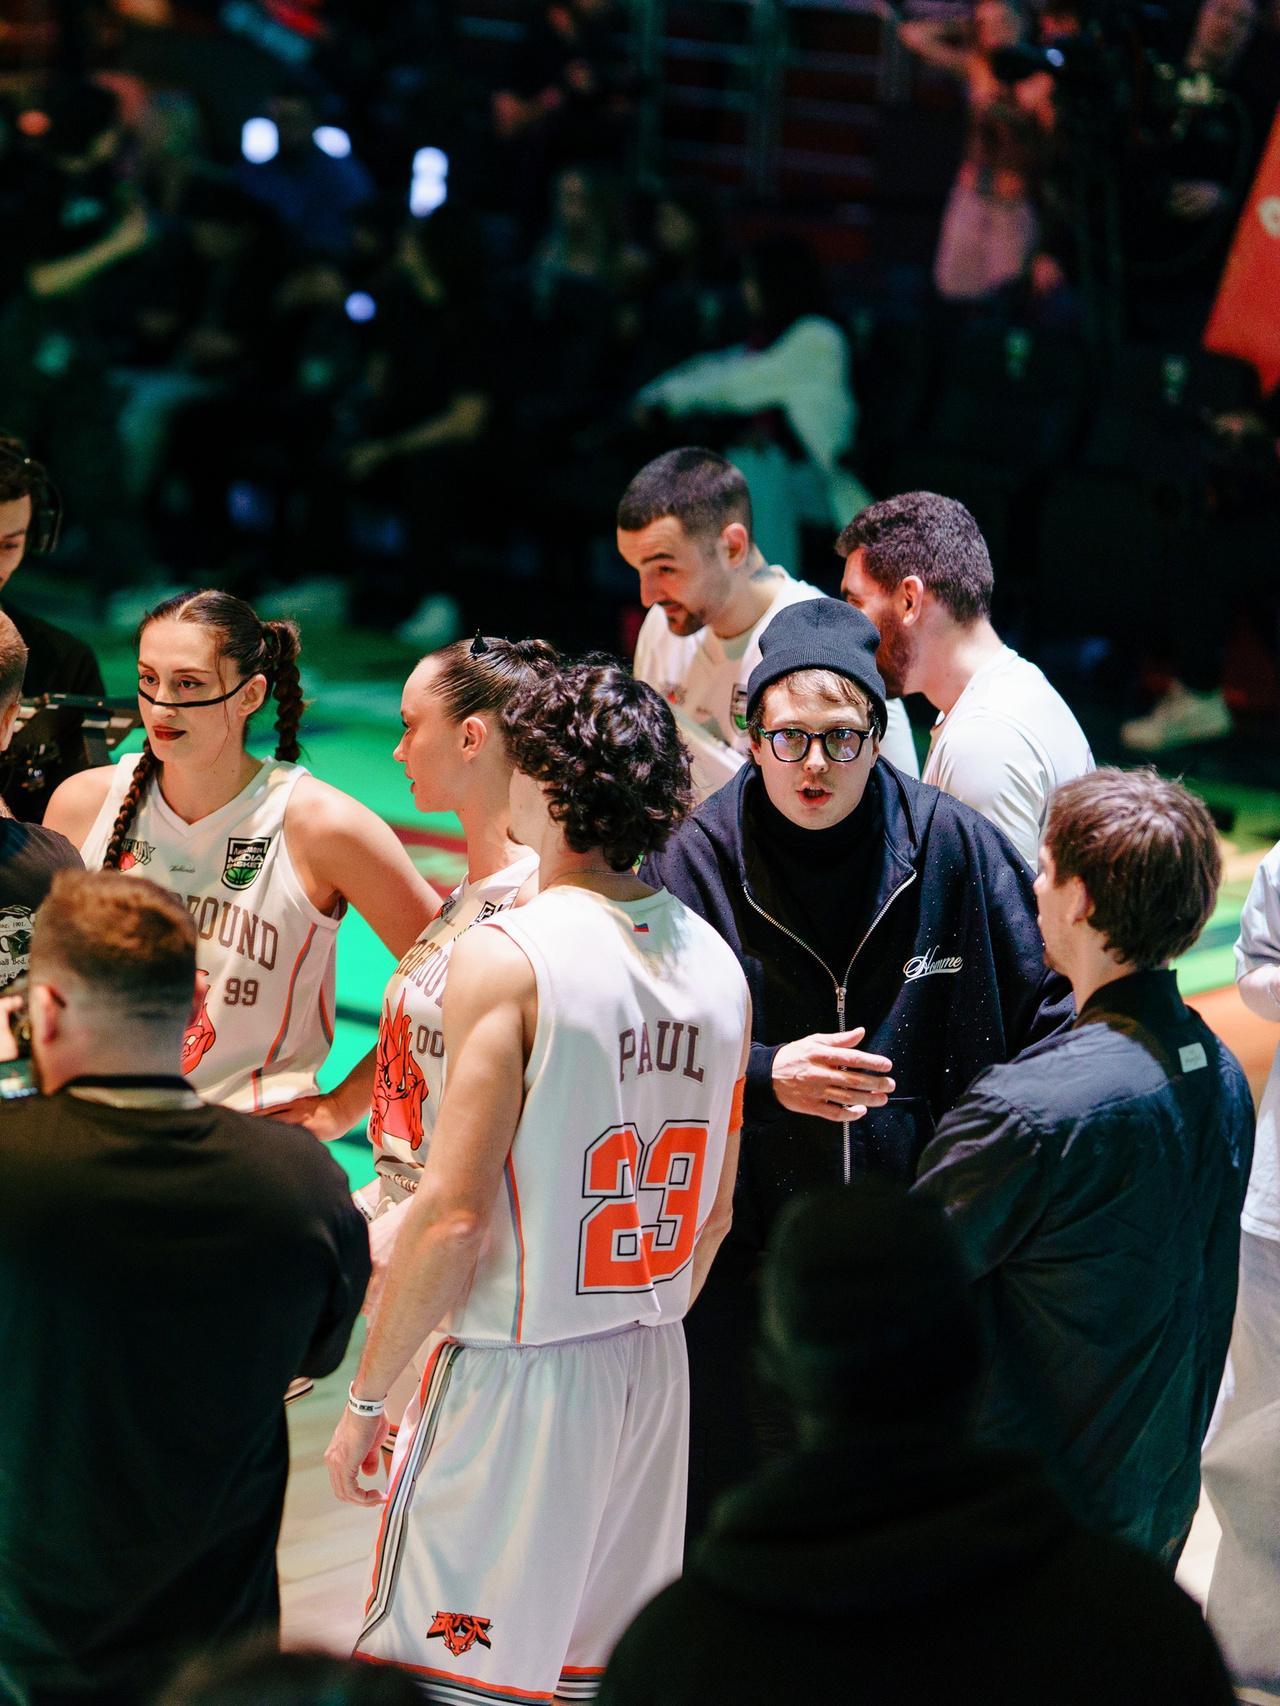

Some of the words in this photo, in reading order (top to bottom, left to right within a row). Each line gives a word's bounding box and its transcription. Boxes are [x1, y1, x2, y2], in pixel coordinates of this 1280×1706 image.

[224, 977, 259, 1006] 99
[619, 1020, 704, 1083] PAUL
[576, 1120, 710, 1295] 23
